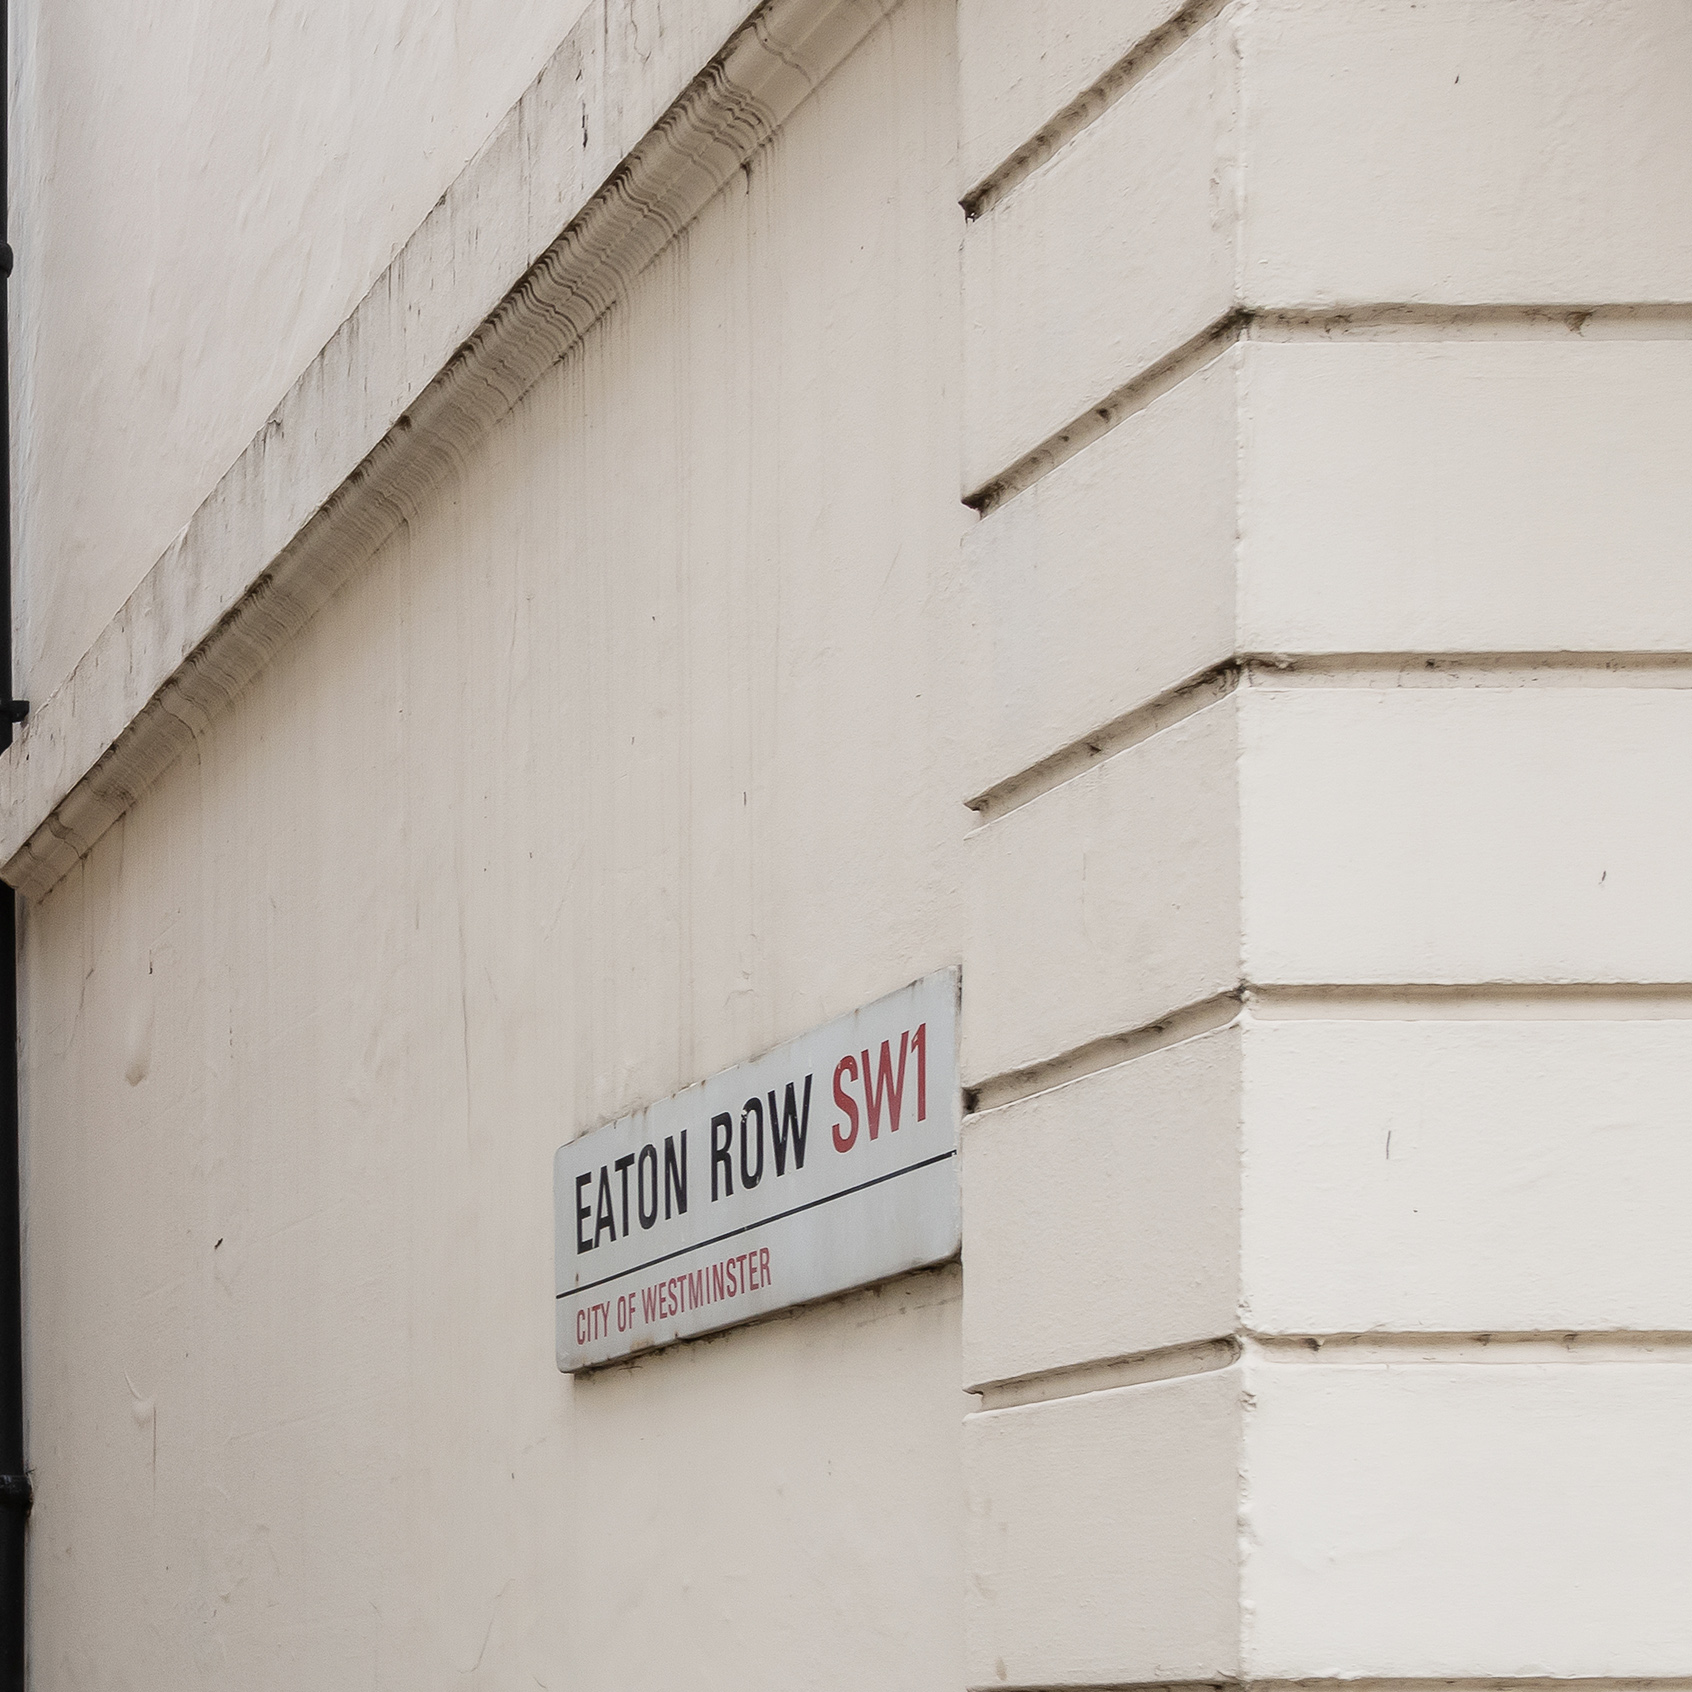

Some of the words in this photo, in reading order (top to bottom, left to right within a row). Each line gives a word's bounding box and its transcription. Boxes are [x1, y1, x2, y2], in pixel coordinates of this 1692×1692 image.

[575, 1129, 687, 1255] EATON
[710, 1073, 813, 1202] ROW
[831, 1022, 926, 1153] SW1
[575, 1301, 610, 1345] CITY
[617, 1292, 636, 1332] OF
[641, 1247, 772, 1325] WESTMINSTER
